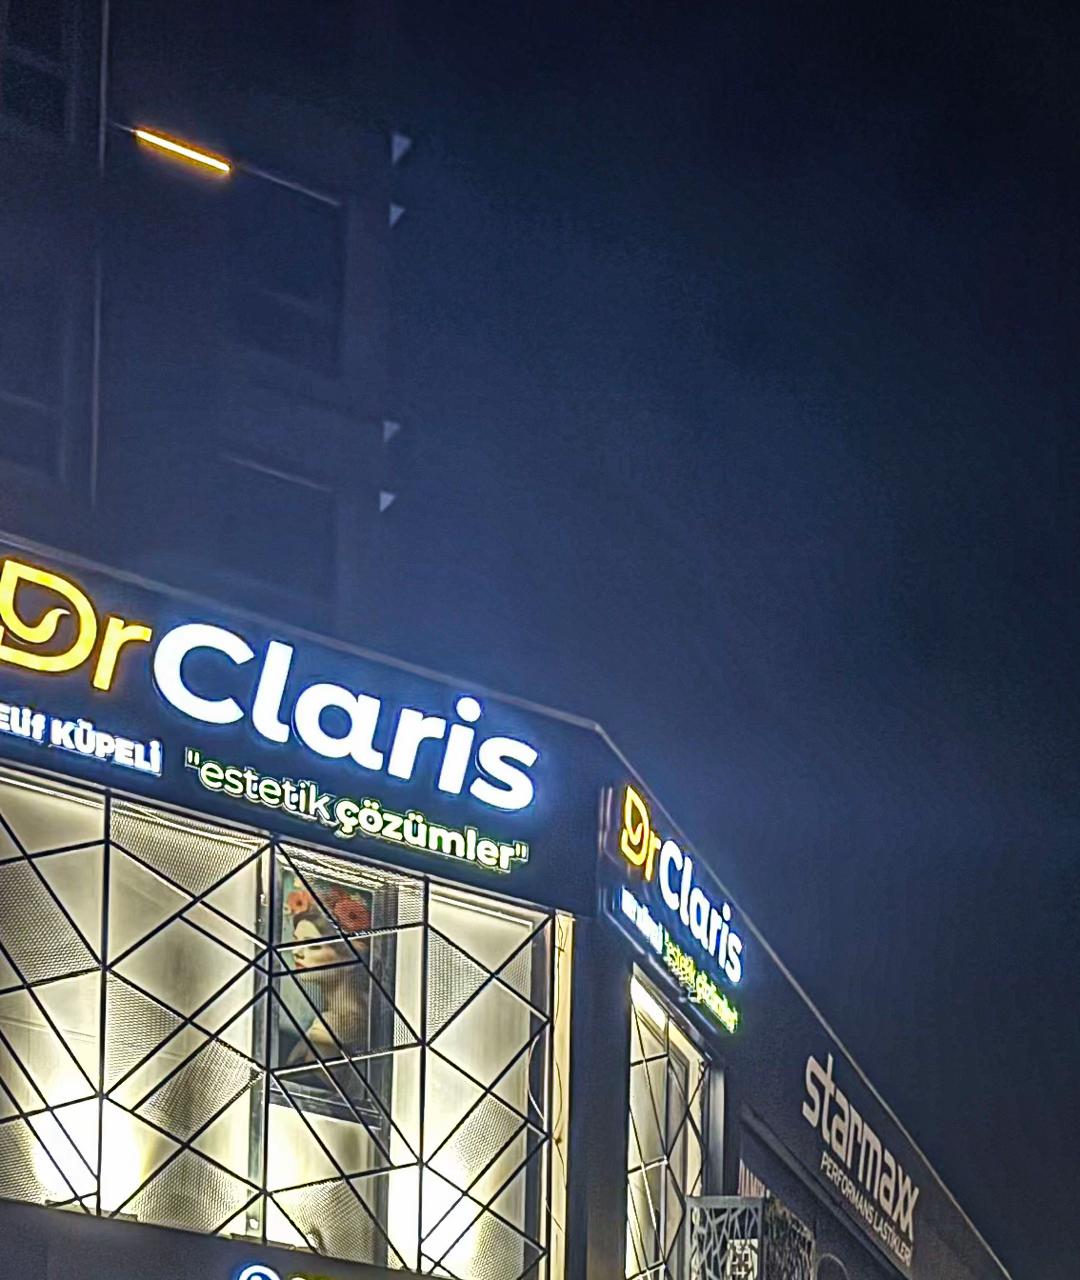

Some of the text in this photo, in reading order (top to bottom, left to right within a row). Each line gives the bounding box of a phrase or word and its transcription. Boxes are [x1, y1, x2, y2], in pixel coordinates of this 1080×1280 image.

[50, 718, 162, 776] KÜPELİ
[802, 1053, 919, 1241] starmaxx
[820, 1152, 874, 1225] PERFORMANS
